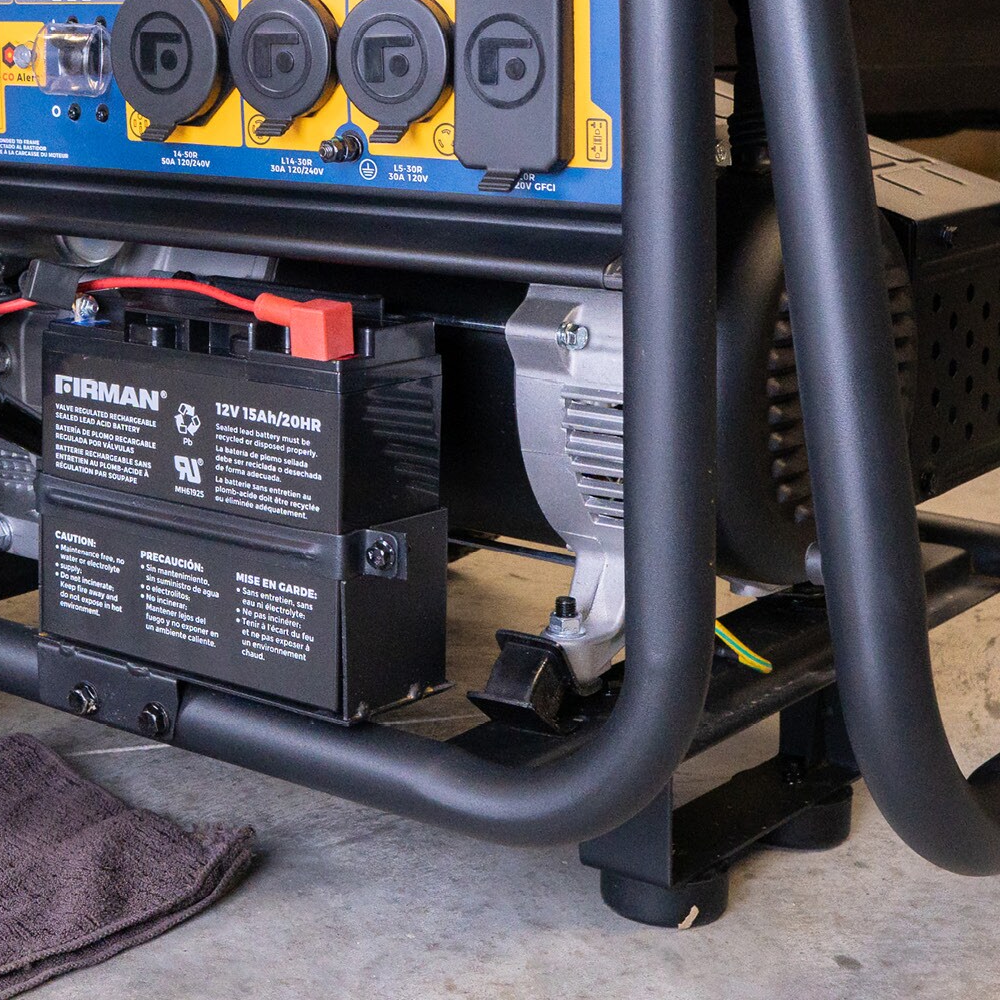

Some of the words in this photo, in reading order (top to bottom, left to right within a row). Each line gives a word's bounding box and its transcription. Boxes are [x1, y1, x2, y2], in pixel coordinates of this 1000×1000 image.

[2, 73, 14, 81] CO
[173, 150, 198, 158] 14-50R
[178, 159, 210, 167] 120/240V
[281, 157, 312, 167] L14-30R
[271, 165, 285, 173] 30A
[288, 166, 324, 175] 120/240V
[389, 172, 405, 181] 30A
[408, 174, 428, 182] 120V
[394, 165, 423, 173] L5-30R
[535, 183, 555, 191] GFCI
[55, 374, 160, 411] FIRMAN
[55, 403, 74, 412] VALVE
[74, 406, 108, 418] REGULATED
[109, 413, 157, 427] RECHARGEABLE
[55, 412, 79, 421] SEALED
[79, 416, 95, 424] LEAD
[96, 419, 112, 427] ACID
[112, 422, 140, 433] BATTERY
[215, 402, 240, 418] 12V
[242, 405, 322, 433] 15Ah/20HR
[55, 422, 81, 434] BATERÍA
[91, 431, 114, 440] PLOMO
[114, 435, 156, 449] RECARGABLE
[55, 432, 88, 444] REGULADA
[88, 439, 102, 447] POR
[102, 440, 135, 453] VÁLVULAS
[183, 437, 194, 446] Pb
[215, 423, 238, 433] Sealed
[239, 427, 254, 436] lead
[255, 430, 281, 442] battery
[282, 435, 300, 444] must
[301, 438, 311, 446] be
[215, 432, 244, 444] recycled
[254, 439, 285, 452] disposed
[286, 445, 318, 458] properly.
[55, 444, 84, 454] BATTERIE
[85, 449, 133, 464] RECHARGEABLE
[134, 459, 152, 468] SANS
[55, 453, 89, 464] ENTRETIEN
[99, 461, 143, 475] PLOMB-ACIDE
[260, 453, 282, 464] plomo
[283, 457, 308, 467] sellada
[55, 460, 94, 474] RÉGULATION
[94, 469, 107, 477] PAR
[108, 472, 138, 484] SOUPAPE
[215, 454, 232, 463] debe
[245, 460, 277, 471] reciclada
[284, 467, 322, 480] desechada
[215, 463, 225, 471] de
[225, 465, 245, 475] forma
[247, 469, 282, 482] adecuada.
[215, 485, 258, 499] plomb-acide
[258, 494, 273, 502] doit
[224, 477, 251, 488] batterie
[252, 484, 268, 492] sans
[269, 486, 301, 498] entretien
[55, 530, 97, 547] CAUTION:
[60, 543, 100, 558] Maintenance
[140, 549, 204, 572] PRECAUCIÓN:
[60, 553, 78, 562] water
[87, 559, 121, 574] electrolyte
[146, 563, 156, 572] Sin
[60, 571, 70, 579] Do
[70, 574, 81, 582] not
[146, 573, 156, 581] sin
[156, 576, 192, 590] suministro
[192, 585, 202, 593] de
[202, 589, 220, 599] agua
[236, 572, 261, 585] MISE
[262, 578, 276, 589] EN
[278, 582, 318, 599] GARDE:
[60, 581, 77, 591] Keep
[77, 585, 88, 593] fire
[88, 589, 105, 599] away
[106, 592, 119, 601] and
[60, 590, 69, 598] do
[69, 592, 80, 601] not
[81, 596, 103, 608] expose
[111, 603, 123, 612] hot
[146, 593, 156, 601] No
[242, 586, 259, 597] Sans
[296, 601, 313, 610] sans
[60, 599, 101, 616] environment.
[146, 603, 177, 616] Mantener
[178, 611, 194, 622] lejos
[195, 615, 206, 624] del
[242, 598, 256, 606] eau
[256, 600, 264, 608] ni
[146, 612, 165, 624] fuego
[181, 623, 209, 636] exponer
[242, 608, 253, 616] Ne
[253, 611, 267, 620] pas
[155, 625, 187, 639] ambiente
[187, 634, 216, 647] caliente.
[241, 628, 250, 636] et
[261, 635, 274, 643] pas
[275, 638, 304, 650] exposer
[242, 617, 260, 628] Tenir
[291, 630, 301, 638] du
[301, 632, 315, 642] feu
[242, 649, 266, 661] chaud.
[252, 640, 306, 660] environnement
